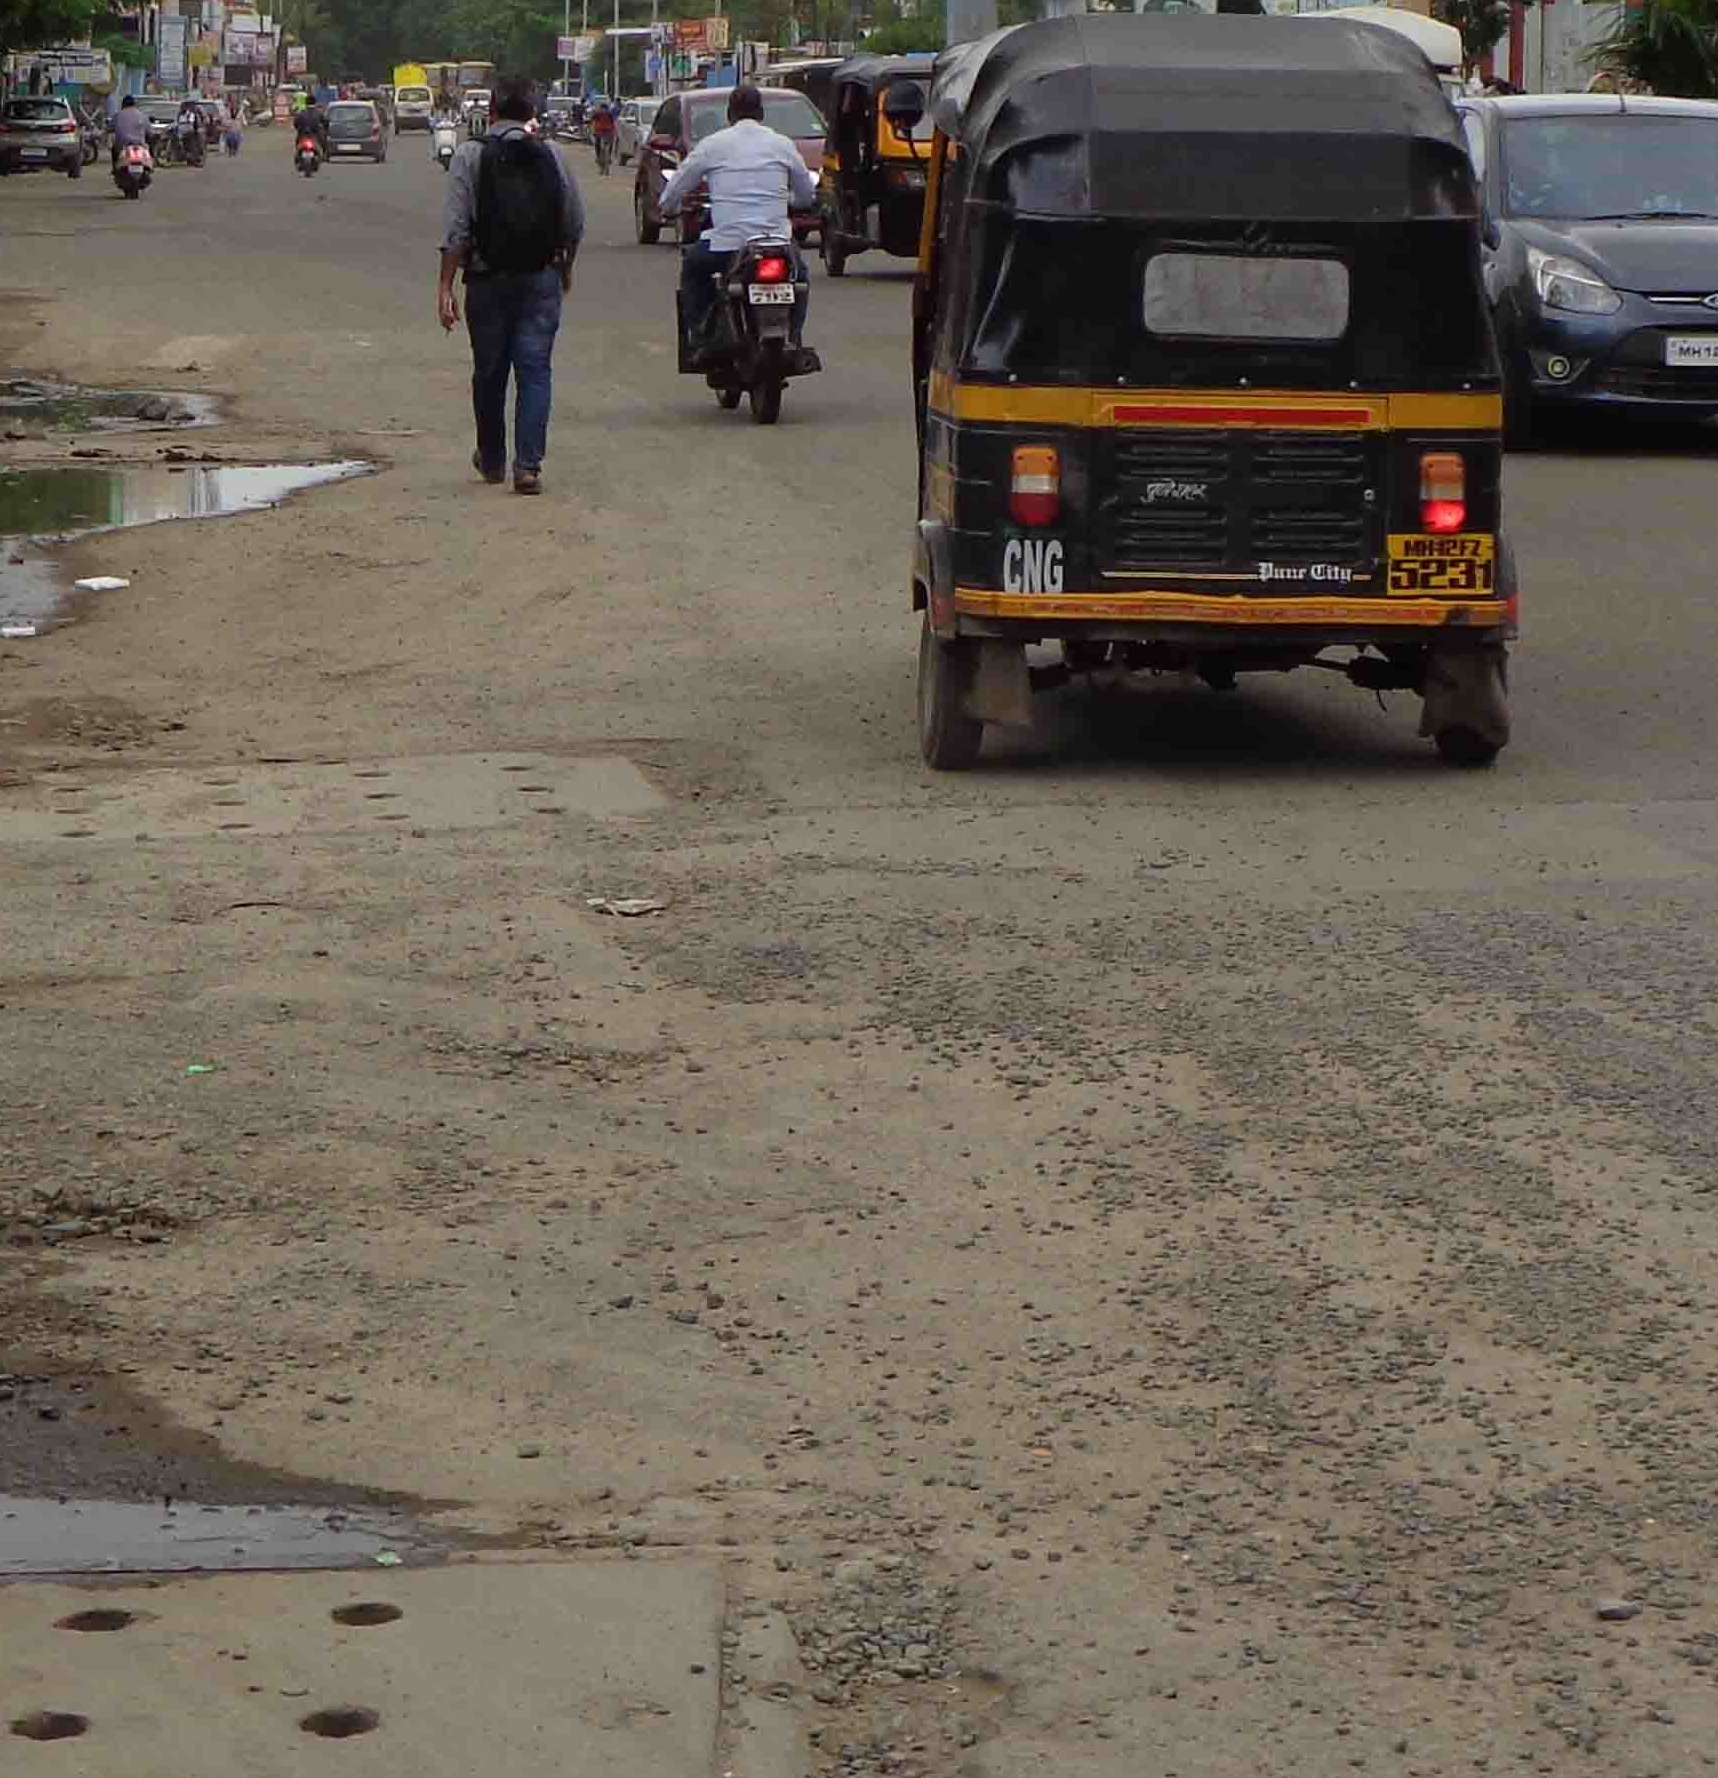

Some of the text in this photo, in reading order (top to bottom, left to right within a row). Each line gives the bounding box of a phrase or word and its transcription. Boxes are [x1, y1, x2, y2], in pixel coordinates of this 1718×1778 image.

[1003, 539, 1064, 594] CNG
[1258, 561, 1353, 585] Pune City
[1390, 558, 1493, 590] 5231
